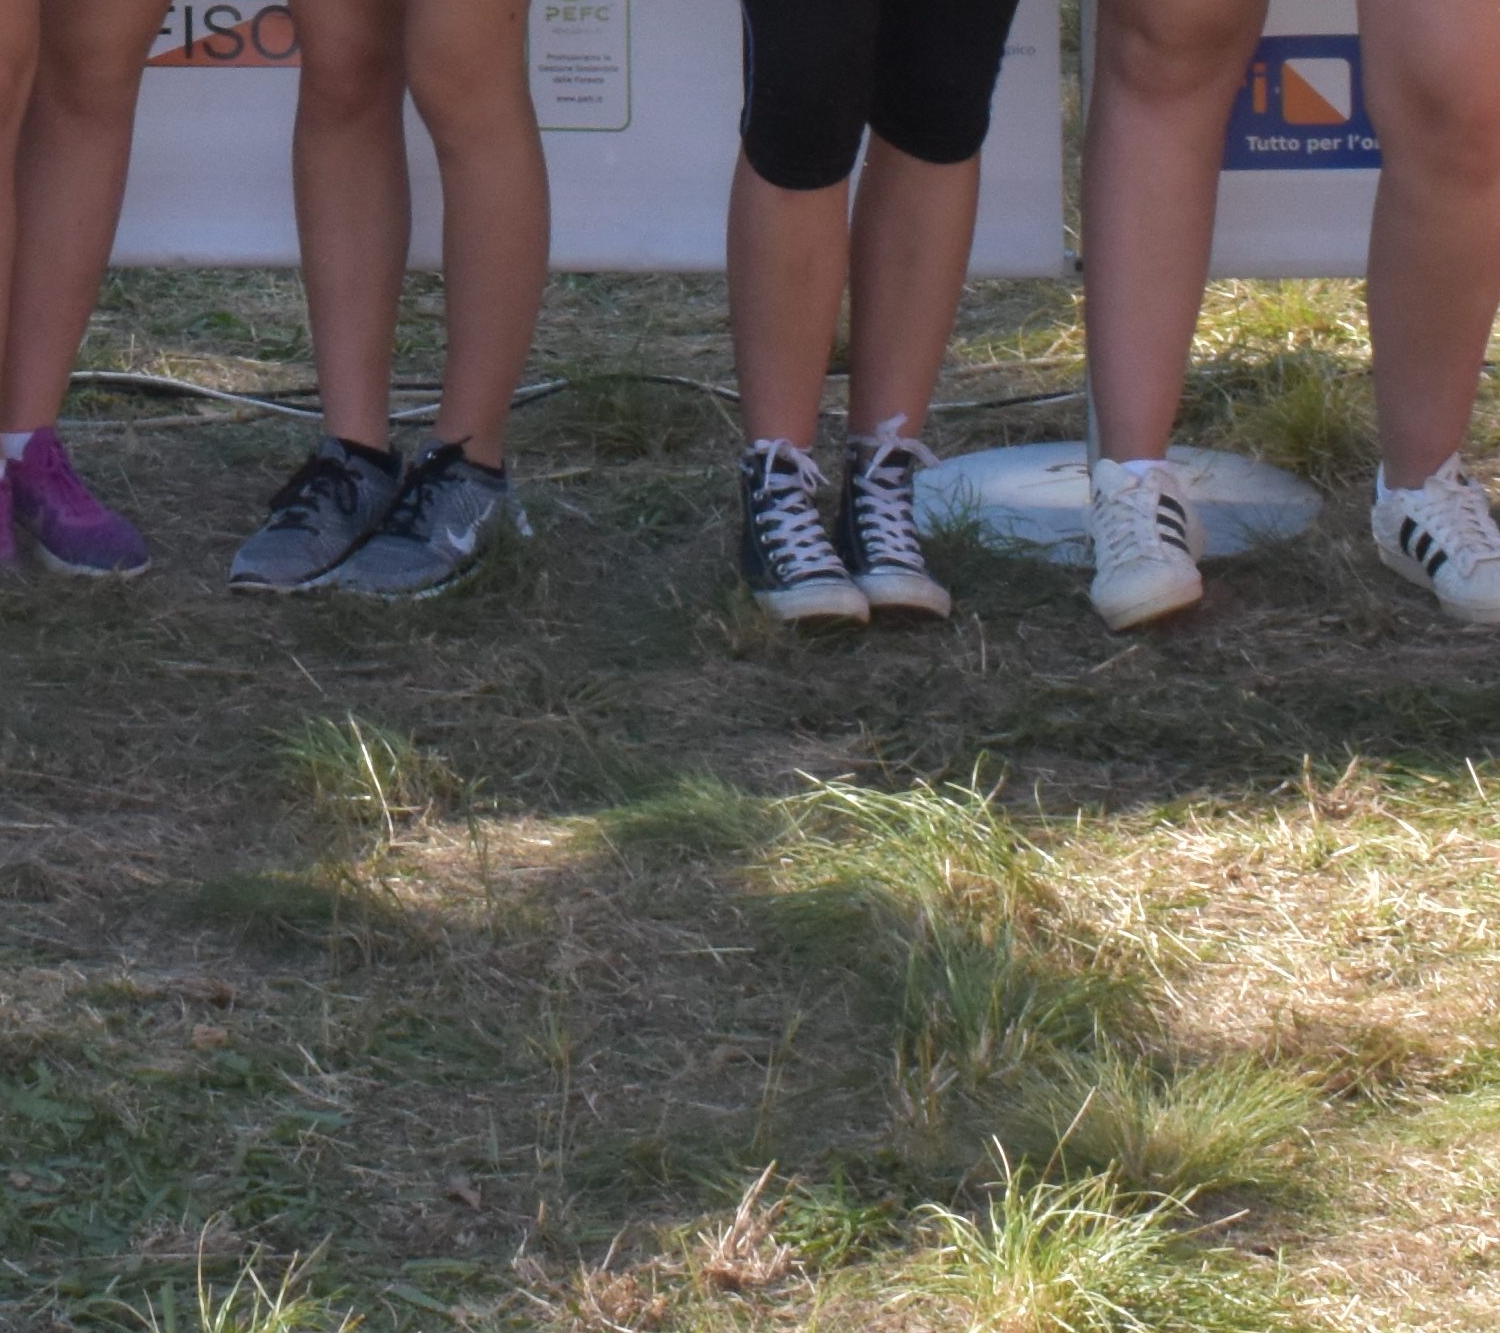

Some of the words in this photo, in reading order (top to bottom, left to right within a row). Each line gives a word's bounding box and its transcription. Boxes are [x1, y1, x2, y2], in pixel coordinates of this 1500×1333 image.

[546, 6, 611, 22] PEFC
[1246, 135, 1300, 151] Tutto
[1307, 136, 1341, 154] per
